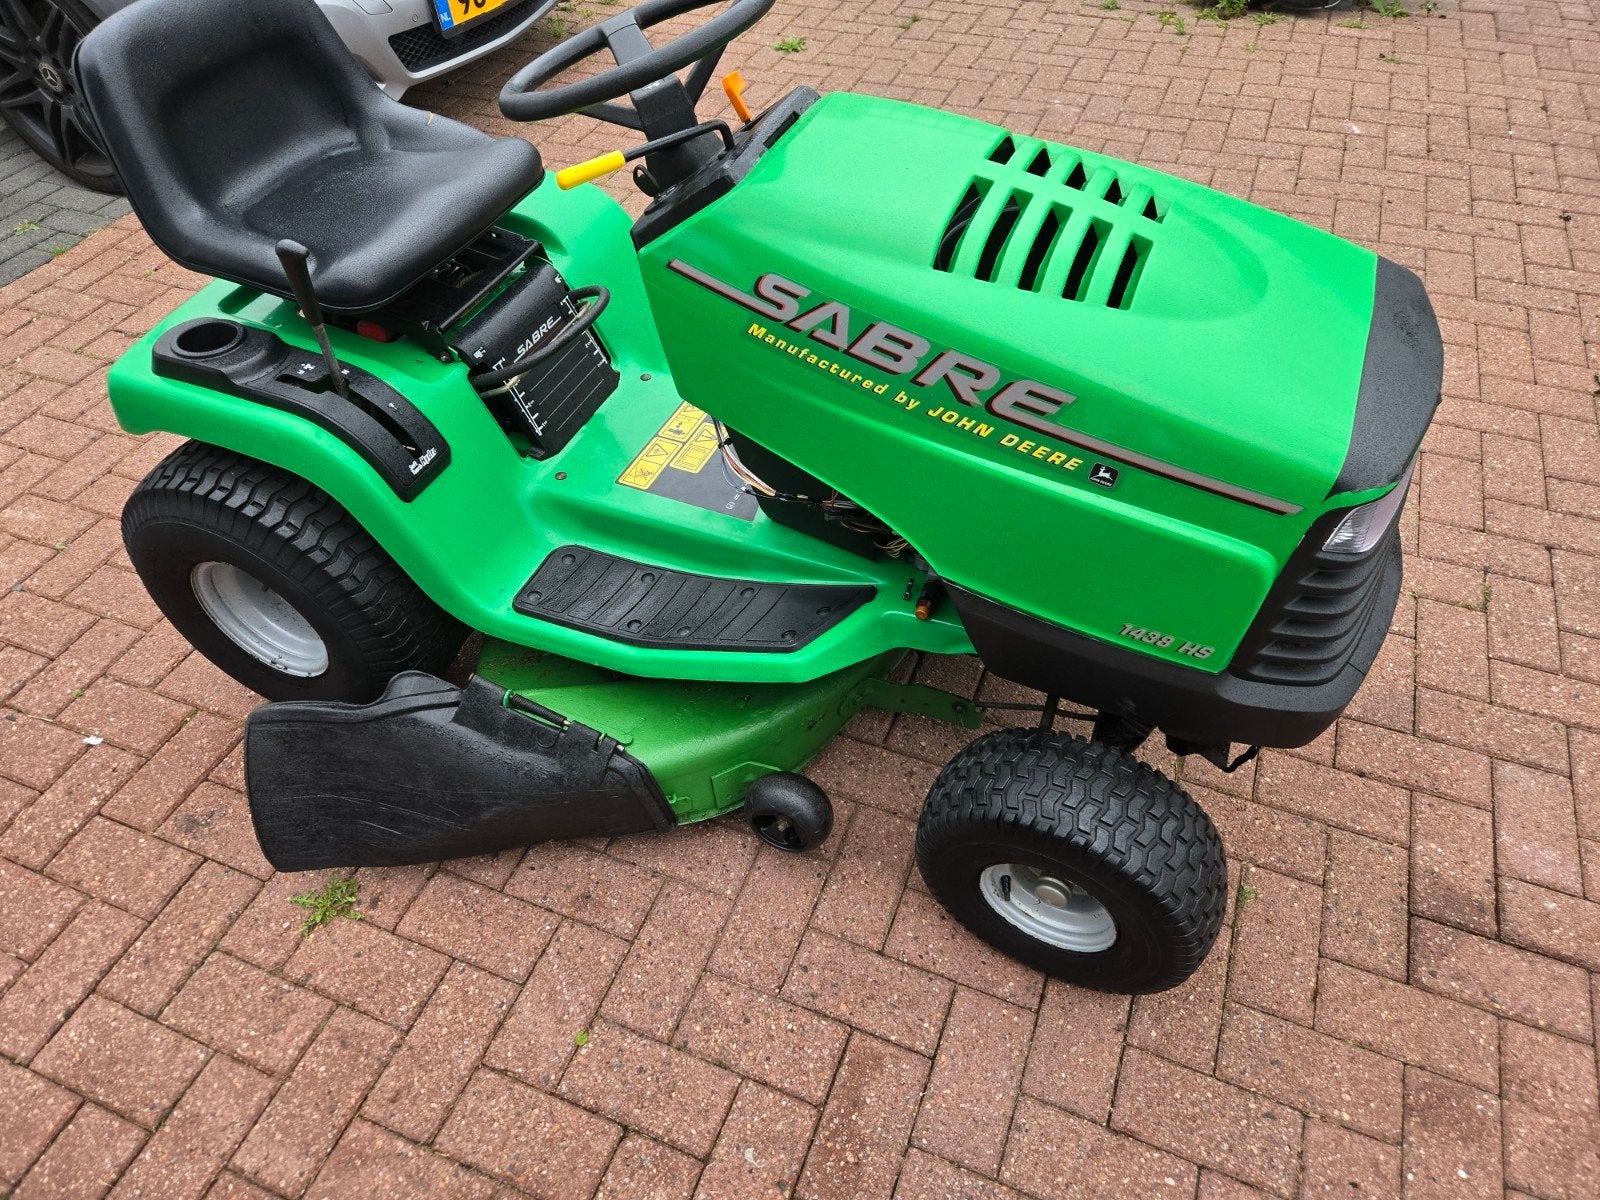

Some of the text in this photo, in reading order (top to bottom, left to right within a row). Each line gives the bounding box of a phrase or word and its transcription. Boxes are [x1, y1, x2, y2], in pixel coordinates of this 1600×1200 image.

[440, 12, 451, 22] NL
[515, 316, 559, 359] SABRE
[742, 272, 1078, 430] SABRE
[747, 323, 1084, 471] Manufactured by JOHN DEERE
[1118, 622, 1216, 659] 1438 HS
